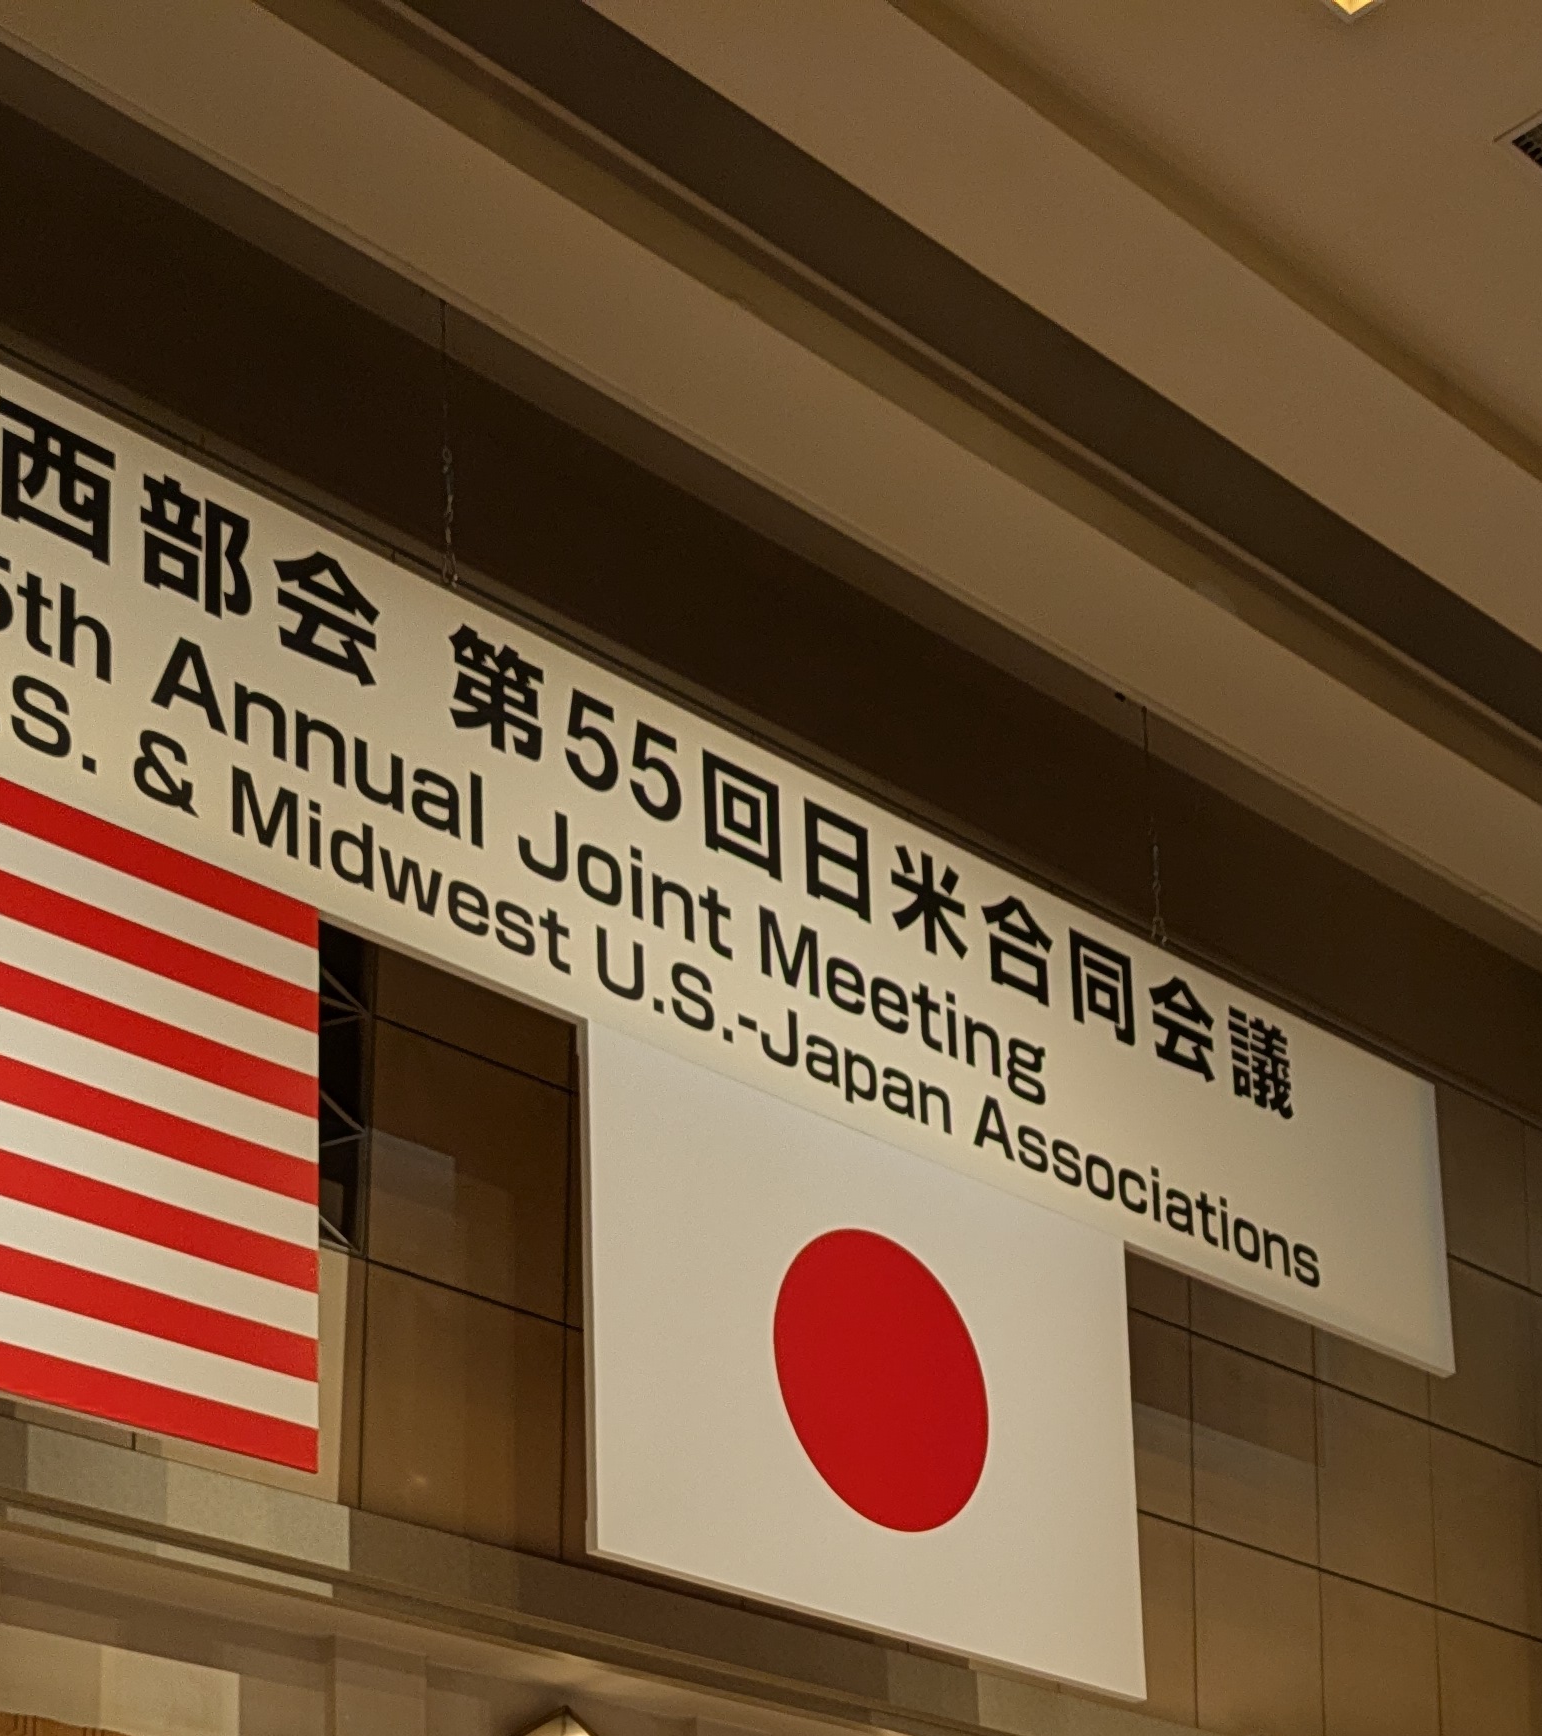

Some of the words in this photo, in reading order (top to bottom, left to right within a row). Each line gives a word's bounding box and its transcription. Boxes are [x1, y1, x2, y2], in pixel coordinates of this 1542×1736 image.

[134, 730, 197, 816] &
[232, 766, 570, 974] Midwest
[597, 926, 952, 1135] U.S.-Japan
[974, 1096, 1319, 1288] Associations
[151, 637, 483, 849] Annual
[518, 811, 733, 960] Joint
[760, 906, 1047, 1106] Meeting
[449, 625, 1293, 1119] 第55回日米合同会議
